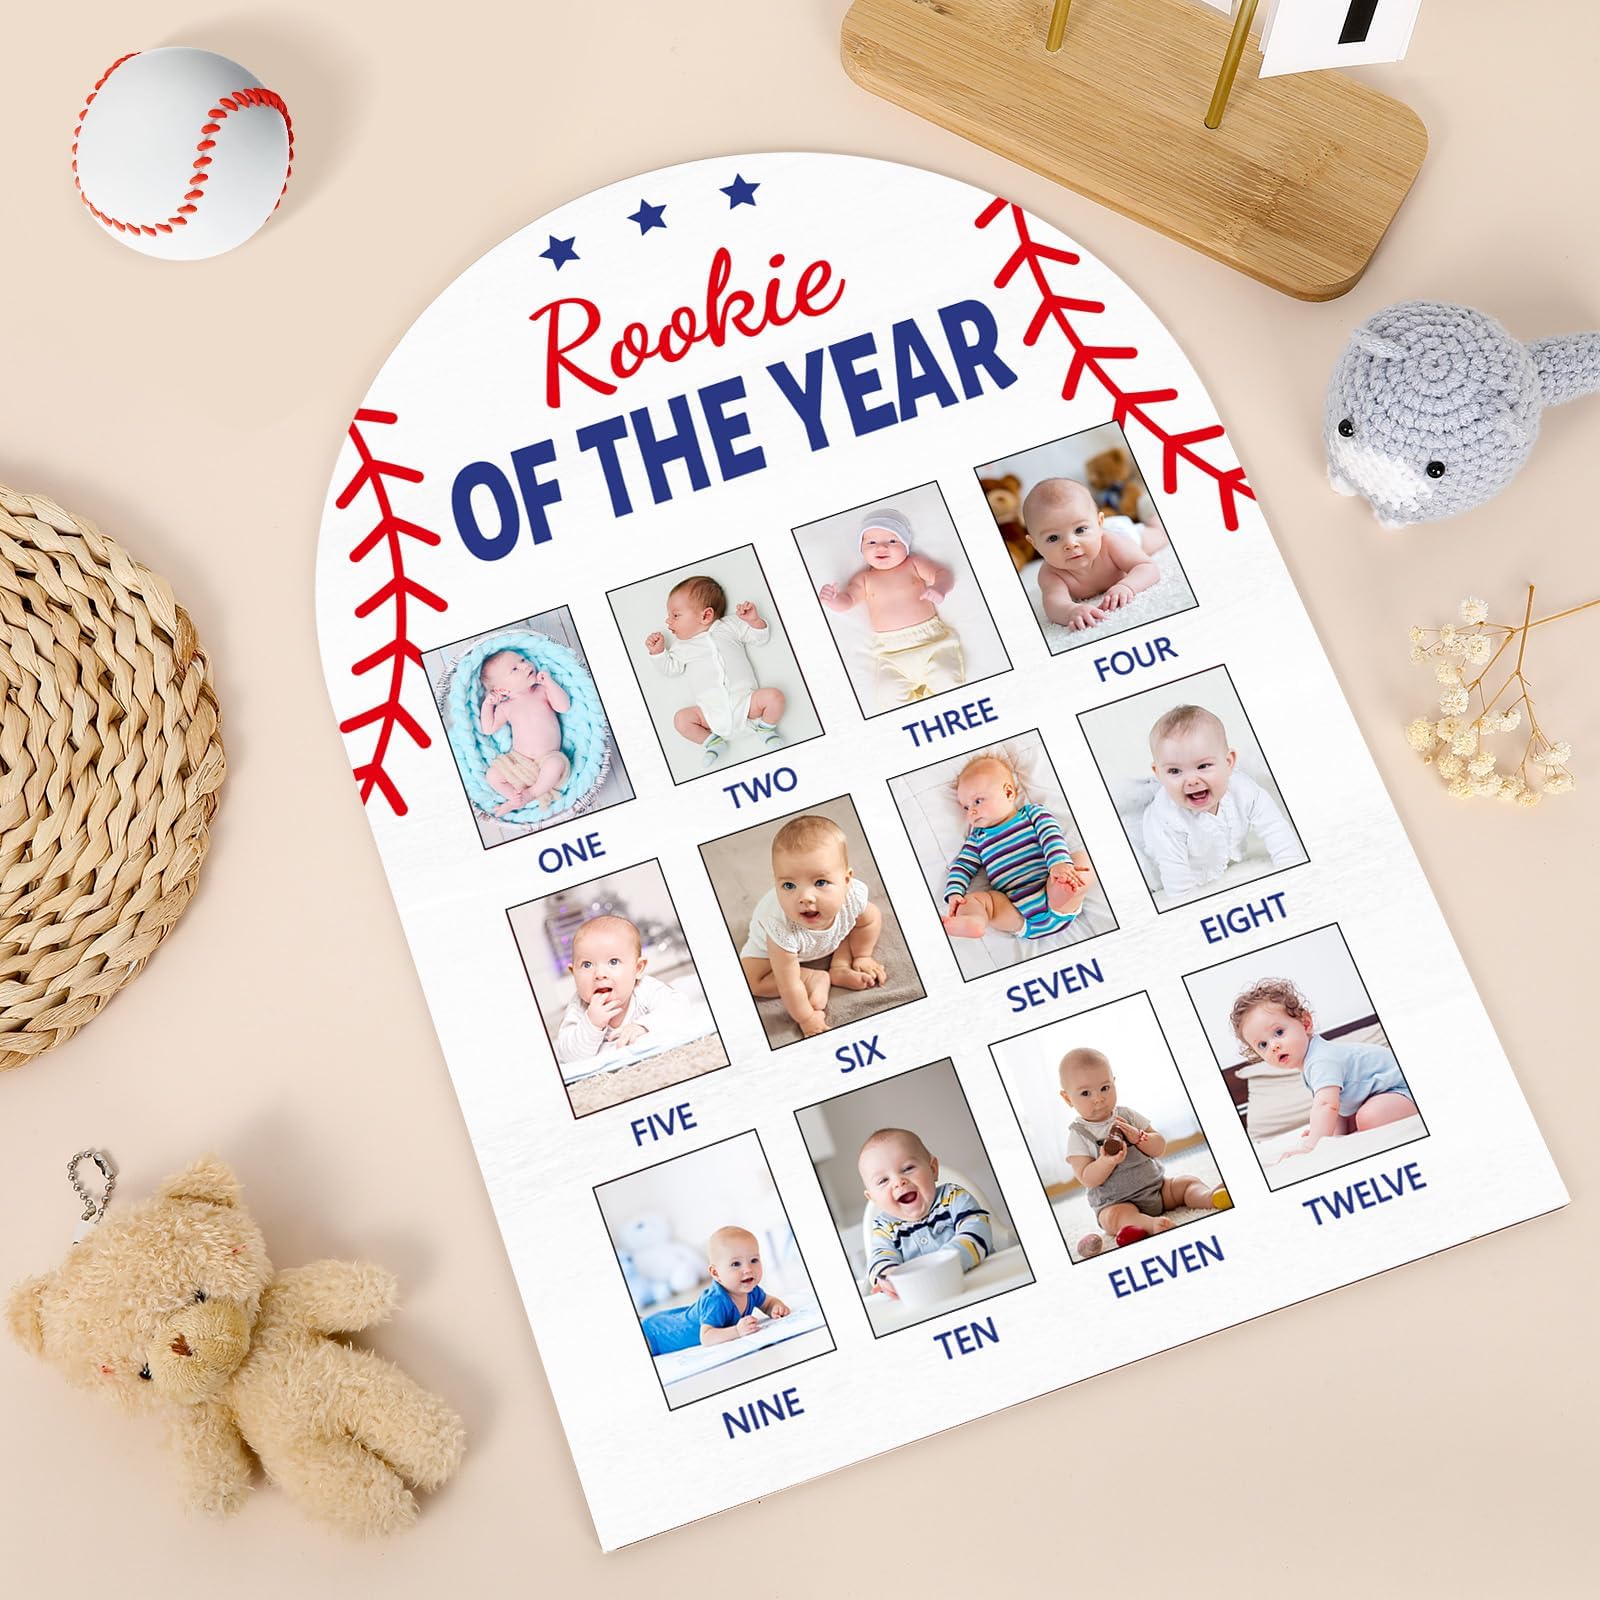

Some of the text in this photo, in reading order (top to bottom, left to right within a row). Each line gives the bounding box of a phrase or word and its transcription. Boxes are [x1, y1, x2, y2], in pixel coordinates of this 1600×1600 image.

[529, 247, 846, 409] Rookie
[451, 299, 1018, 562] OF THE YEAR
[1094, 637, 1179, 683] FOUR
[903, 697, 999, 748] THREE
[724, 767, 798, 810] TWO
[538, 832, 606, 875] ONE
[1200, 891, 1289, 945] EIGHT
[1007, 959, 1105, 1014] SEVEN
[835, 1036, 886, 1073] SIX
[631, 1103, 697, 1146] FIVE
[1303, 1163, 1426, 1226] TWELVE
[1108, 1236, 1224, 1298] ELEVEN
[933, 1317, 999, 1361] TEN
[722, 1387, 805, 1438] NINE
